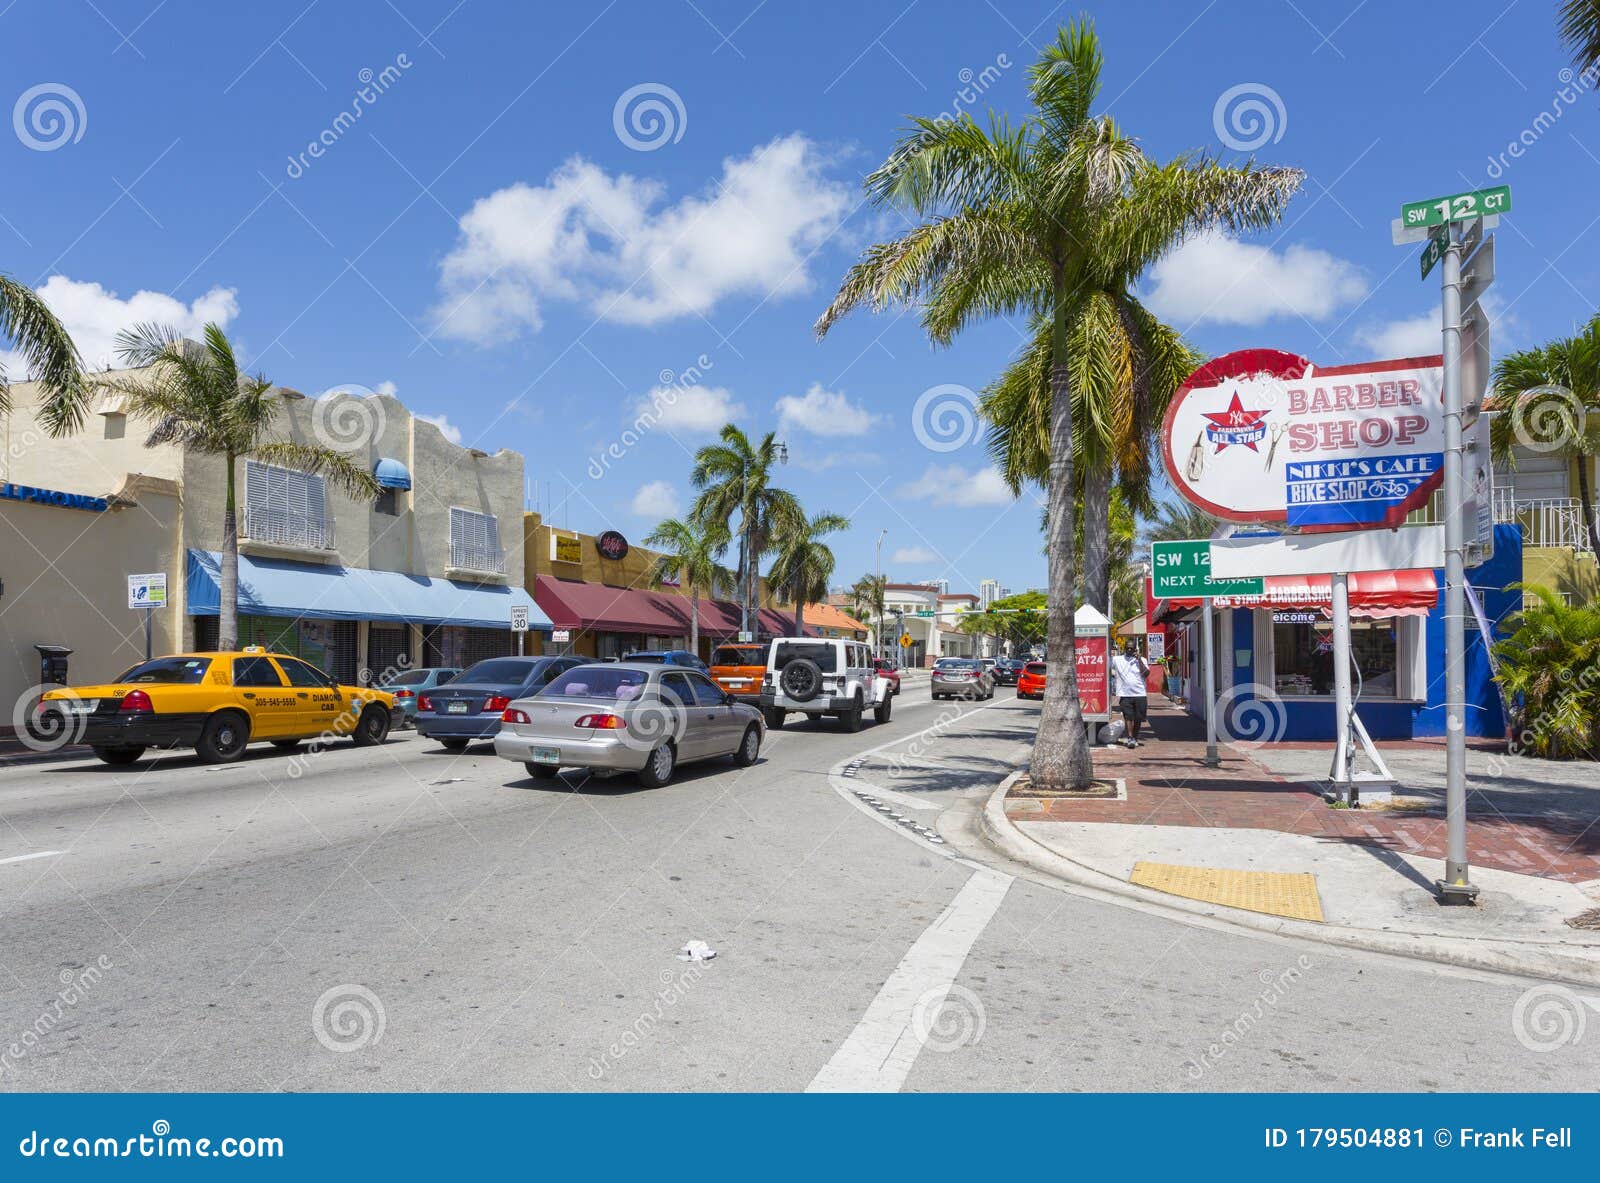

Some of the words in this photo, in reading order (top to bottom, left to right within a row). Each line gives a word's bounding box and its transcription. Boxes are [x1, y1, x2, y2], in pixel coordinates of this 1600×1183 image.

[1408, 208, 1428, 222] SW
[1434, 195, 1478, 221] 12
[1484, 193, 1505, 209] CT
[1430, 241, 1439, 264] 8
[1288, 379, 1422, 415] BARBER
[1211, 433, 1229, 443] ALL
[1236, 431, 1263, 444] STAR
[1288, 415, 1429, 452] SHOP
[1375, 457, 1433, 474] CAFE
[1156, 553, 1182, 567] SW
[1193, 552, 1210, 566] 12
[1160, 575, 1196, 587] NEXT
[1269, 584, 1333, 604] BARBERSHO
[514, 618, 526, 629] 30
[1272, 613, 1316, 622] elcome
[1075, 655, 1104, 665] AT24
[312, 694, 343, 703] DIAMOND
[321, 703, 335, 712] CAB
